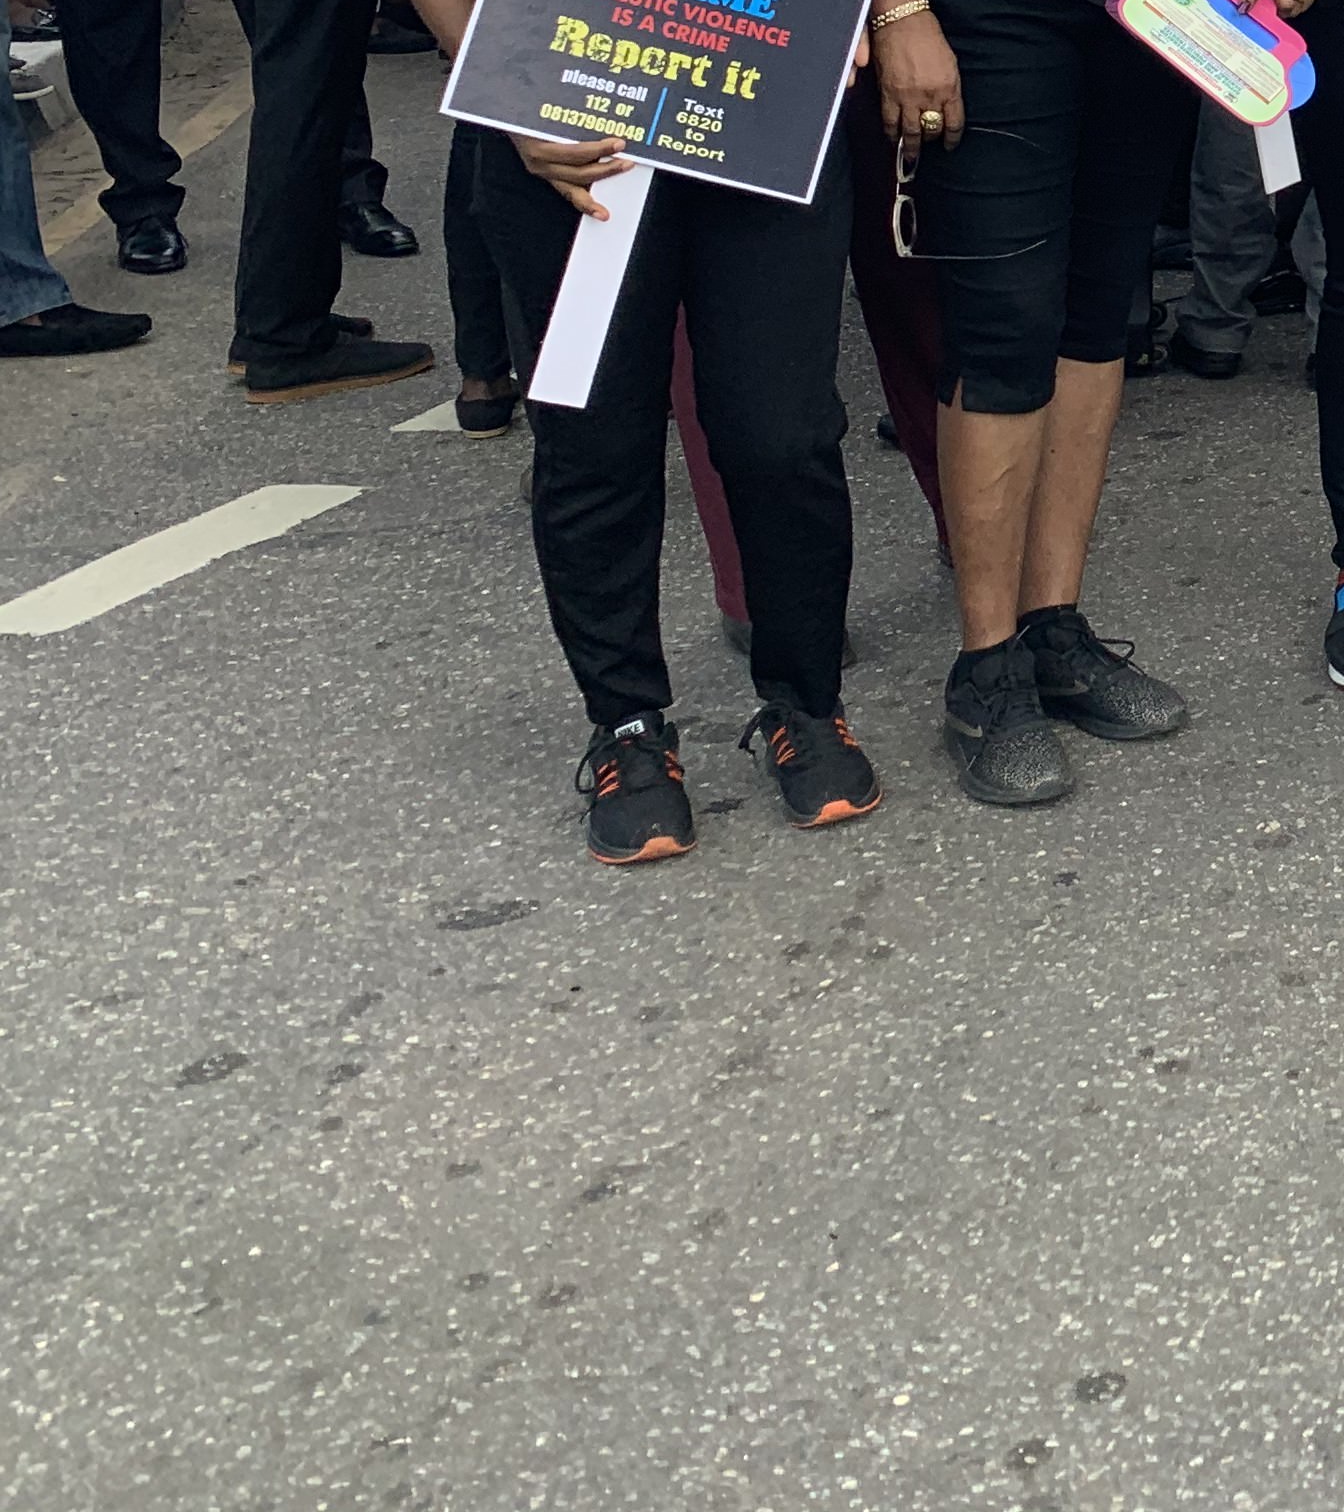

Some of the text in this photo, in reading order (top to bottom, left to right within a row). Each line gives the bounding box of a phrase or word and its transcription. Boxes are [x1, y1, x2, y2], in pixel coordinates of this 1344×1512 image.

[611, 6, 731, 53] IS A CRIME
[682, 3, 791, 47] VIOLENCE
[550, 15, 761, 100] Report it
[561, 68, 649, 102] please call
[585, 94, 635, 118] 112 or
[684, 98, 725, 119] Text
[539, 103, 646, 143] 08137960048
[675, 111, 723, 133] 6820
[685, 127, 705, 142] to
[657, 134, 725, 162] Report
